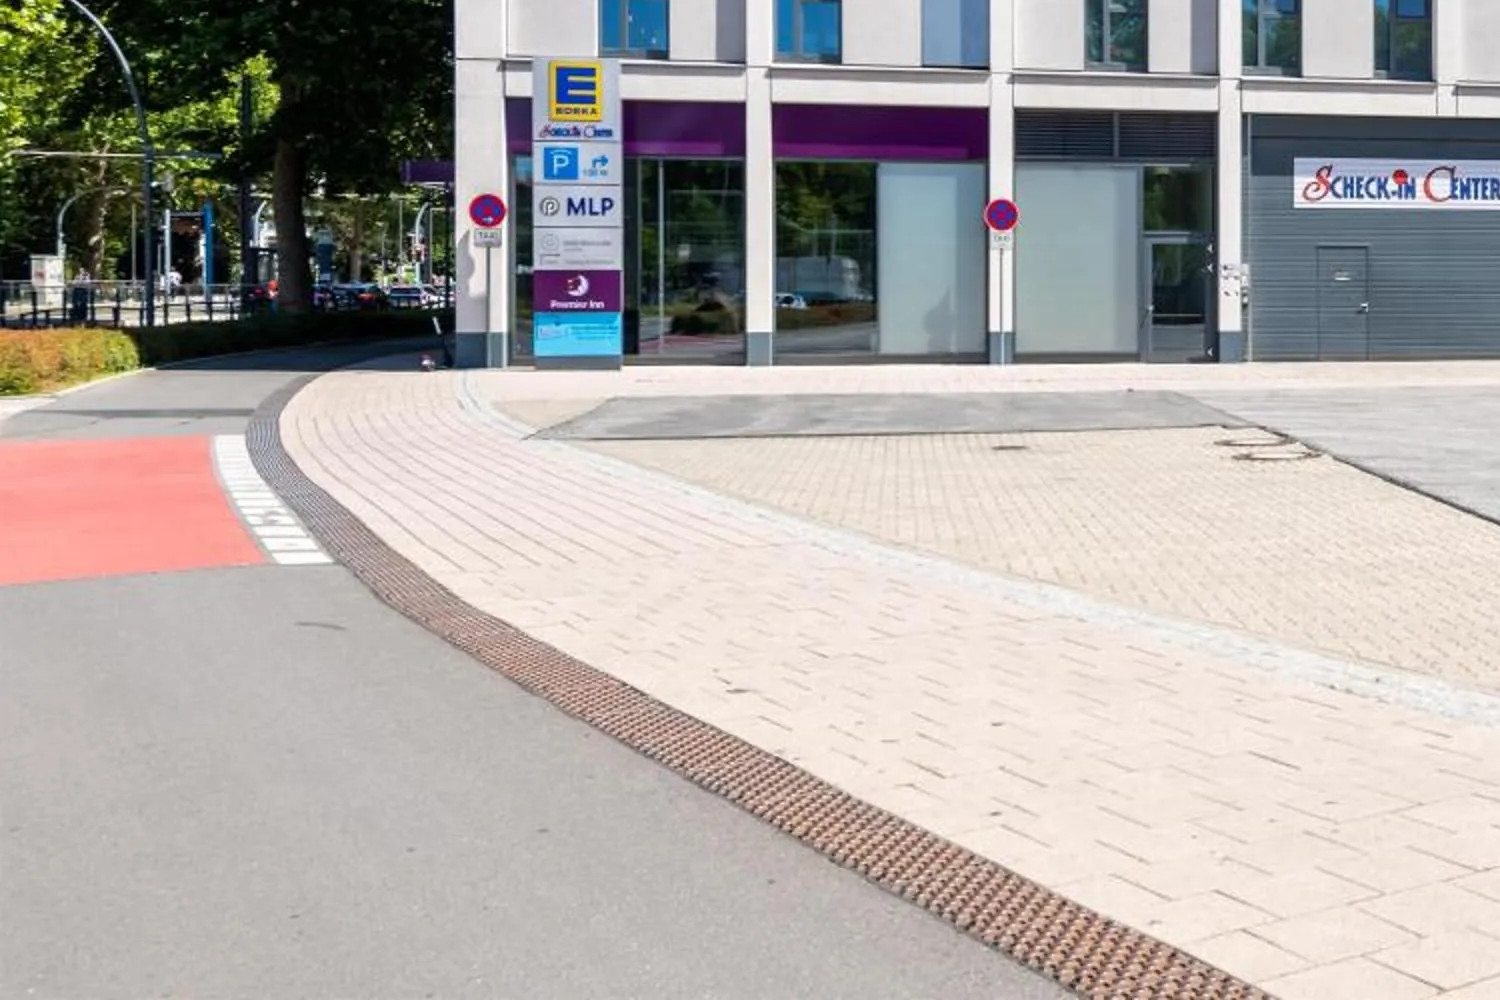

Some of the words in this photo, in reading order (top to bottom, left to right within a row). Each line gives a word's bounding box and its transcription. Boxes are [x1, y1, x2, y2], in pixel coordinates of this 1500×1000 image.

[556, 67, 596, 105] E
[553, 154, 569, 176] P
[567, 197, 615, 217] MLP
